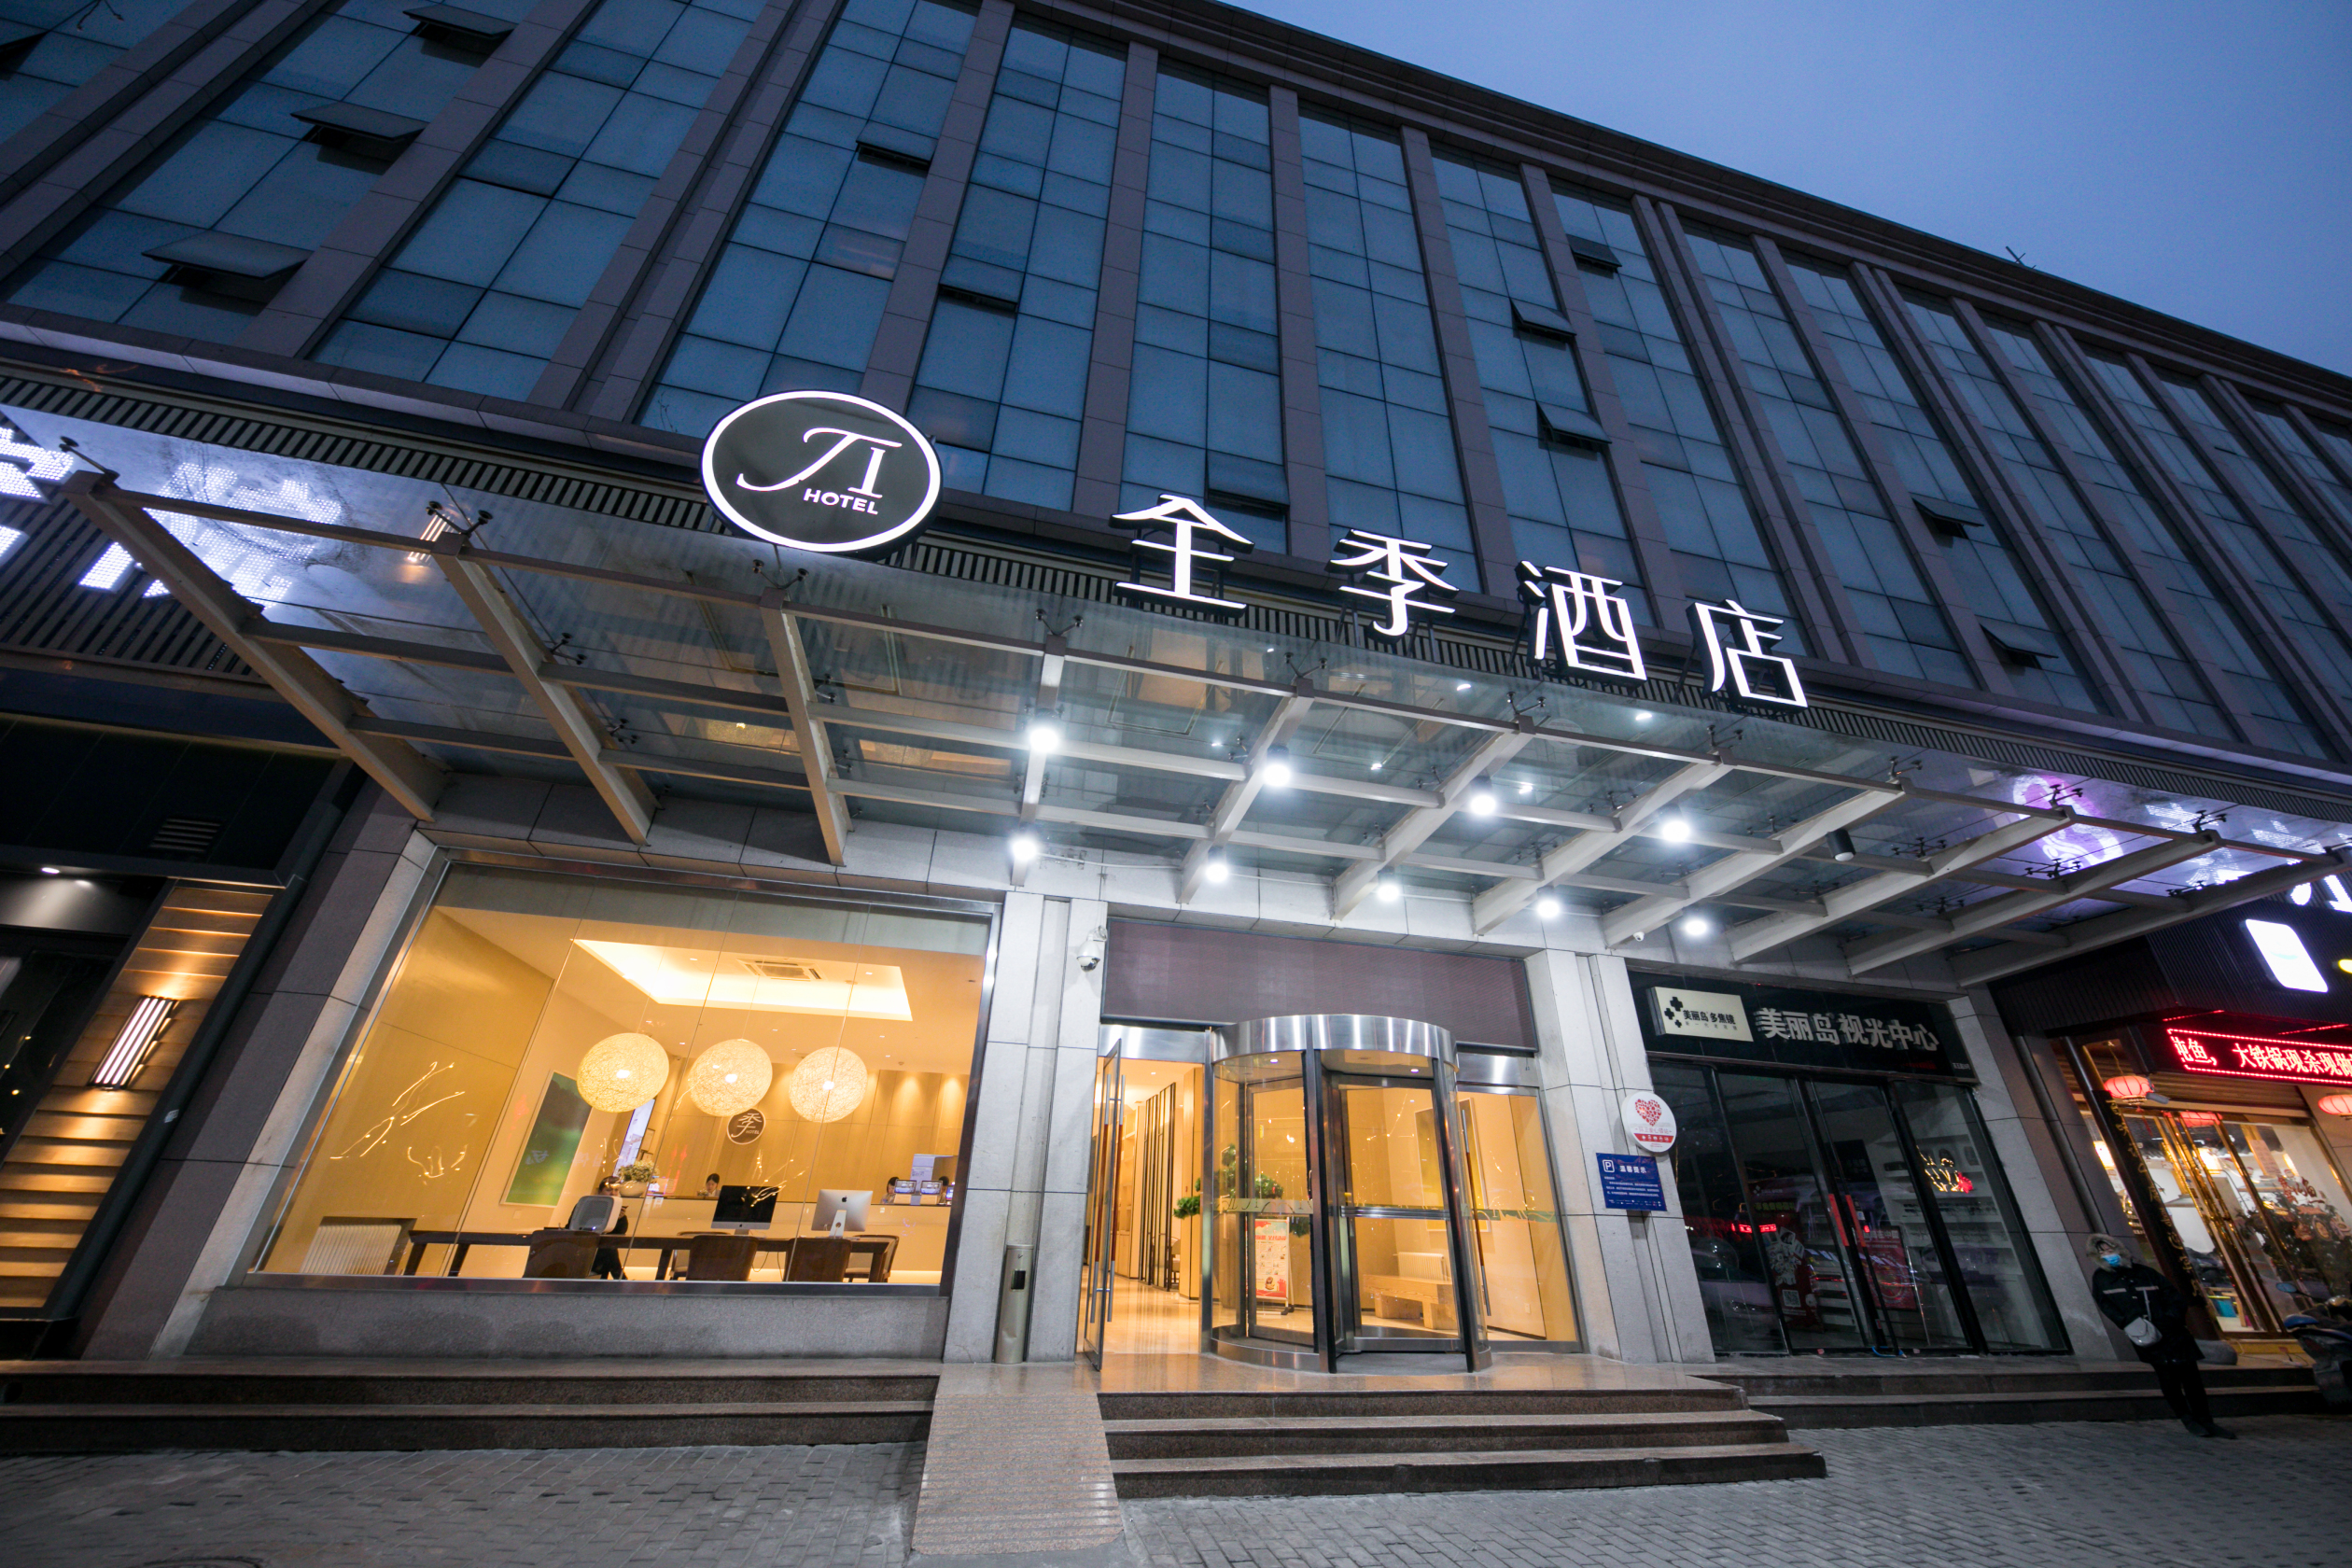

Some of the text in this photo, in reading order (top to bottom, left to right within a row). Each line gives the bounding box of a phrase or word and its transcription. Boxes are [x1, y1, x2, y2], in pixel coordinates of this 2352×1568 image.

[802, 487, 879, 516] HOTEL
[1111, 493, 1809, 708] 全季酒店
[1755, 1007, 1940, 1052] 美丽岛视光中心
